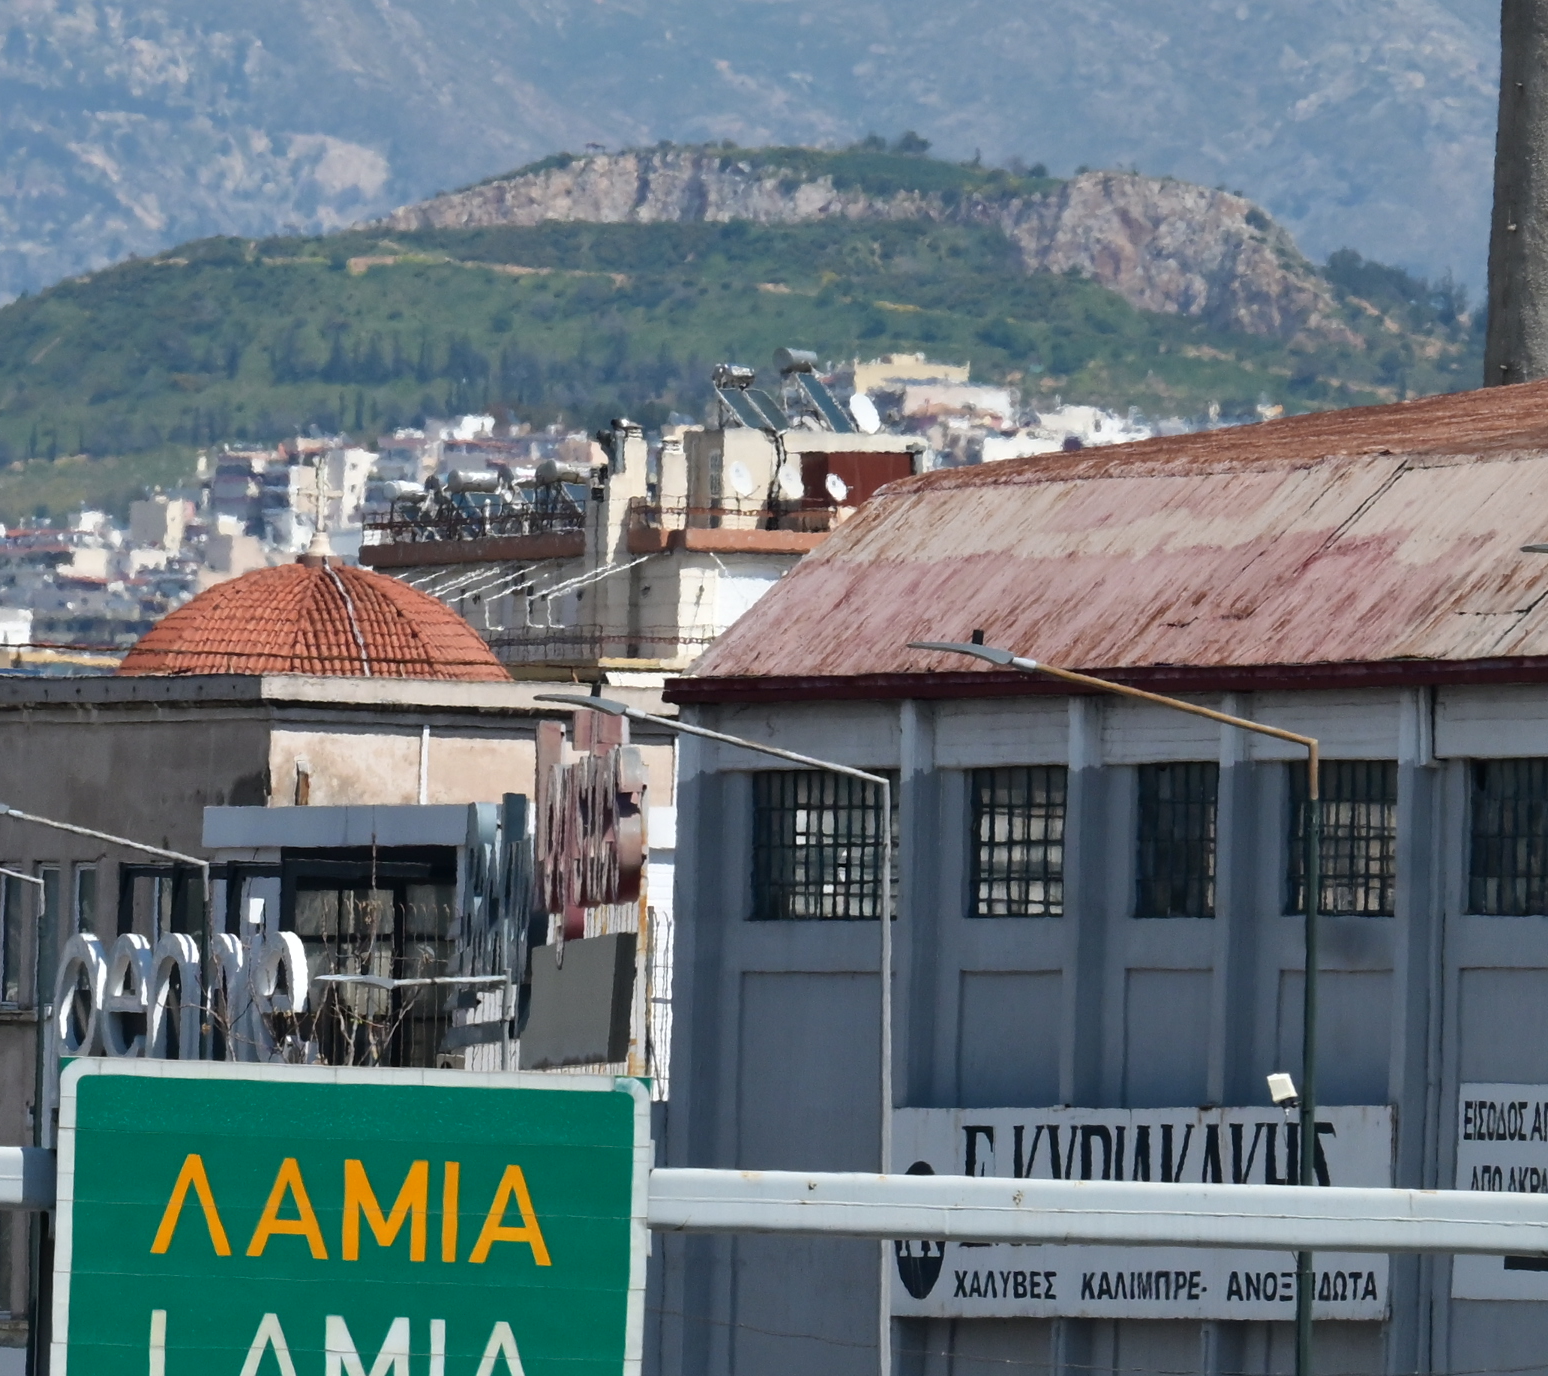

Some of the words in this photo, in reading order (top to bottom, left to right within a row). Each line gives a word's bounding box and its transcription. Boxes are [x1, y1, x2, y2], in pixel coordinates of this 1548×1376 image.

[1463, 1100, 1528, 1141] ΕΙΣΟΔΟΣ
[150, 1153, 553, 1267] ΛΑΜΙΑ
[954, 1270, 1058, 1300] ΧΑΛΥΒΕΣ
[1226, 1270, 1378, 1302] ΑΝΟΞΙΔΩΤΑ
